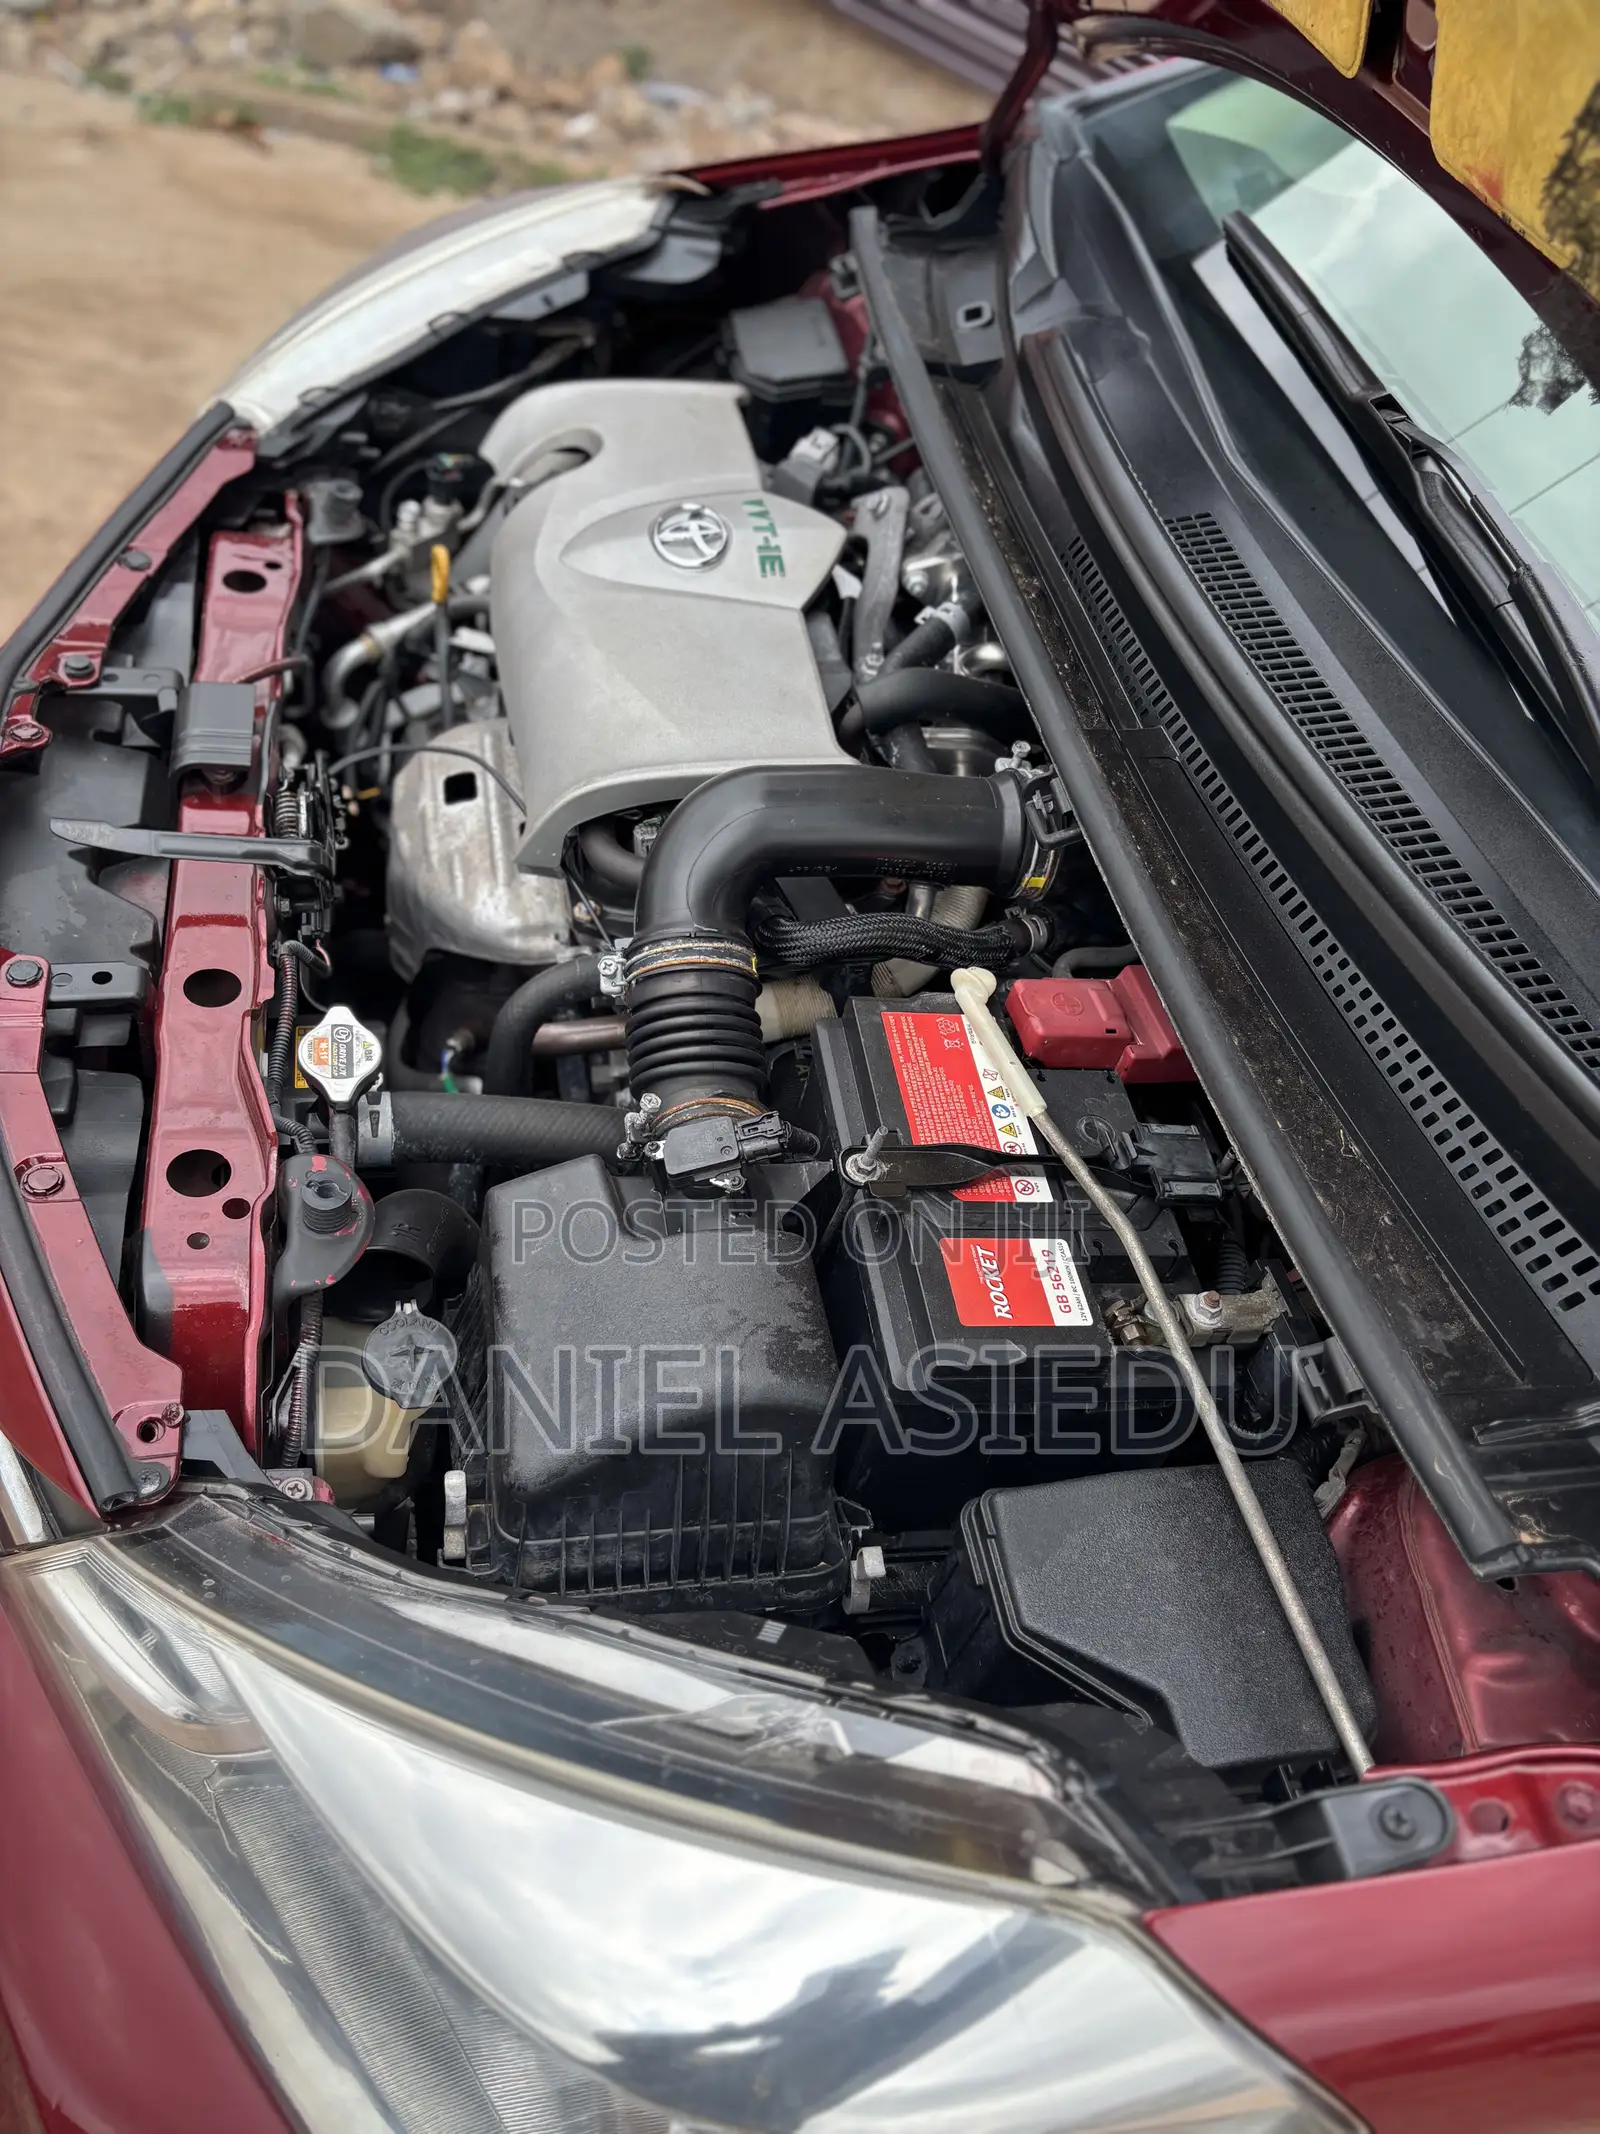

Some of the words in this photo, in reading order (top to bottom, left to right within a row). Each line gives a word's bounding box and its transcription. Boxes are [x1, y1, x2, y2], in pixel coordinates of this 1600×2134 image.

[976, 1244, 1013, 1320] ROCKET
[1041, 1249, 1065, 1291] 56219
[1056, 1295, 1072, 1314] GB
